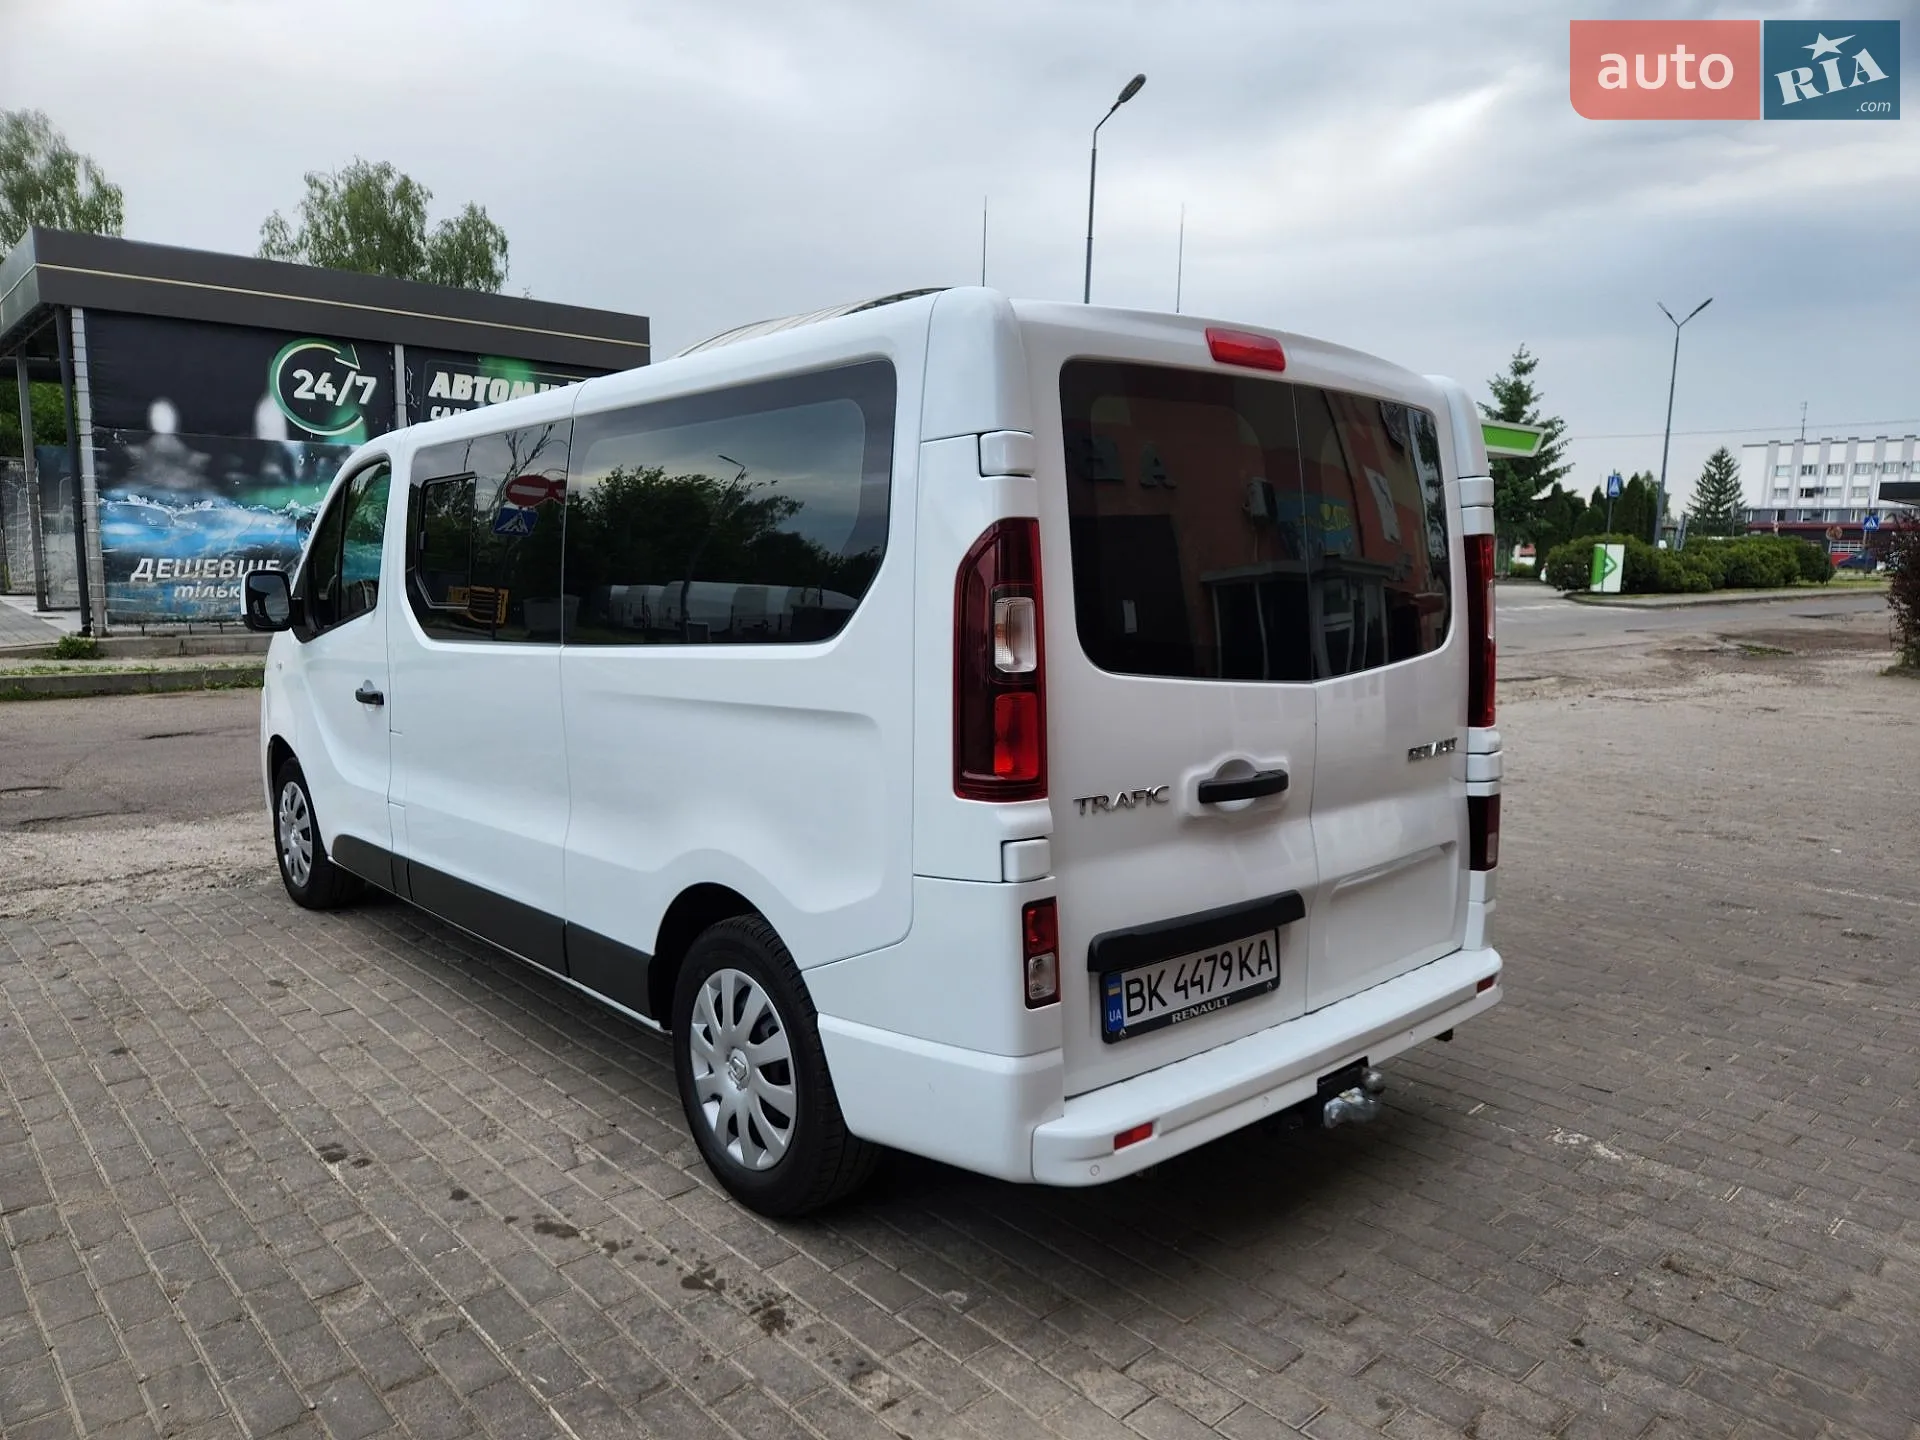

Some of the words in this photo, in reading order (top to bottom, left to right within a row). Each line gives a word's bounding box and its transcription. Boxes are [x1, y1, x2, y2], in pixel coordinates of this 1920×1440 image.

[292, 369, 377, 407] 24/7
[428, 371, 578, 404] АВТОМ
[1072, 784, 1170, 816] TRAFIC
[1125, 968, 1169, 1019] BK
[1173, 950, 1234, 1001] 4479
[1238, 939, 1274, 982] KA
[1108, 1008, 1123, 1023] UA
[1171, 995, 1231, 1024] RENAULT
